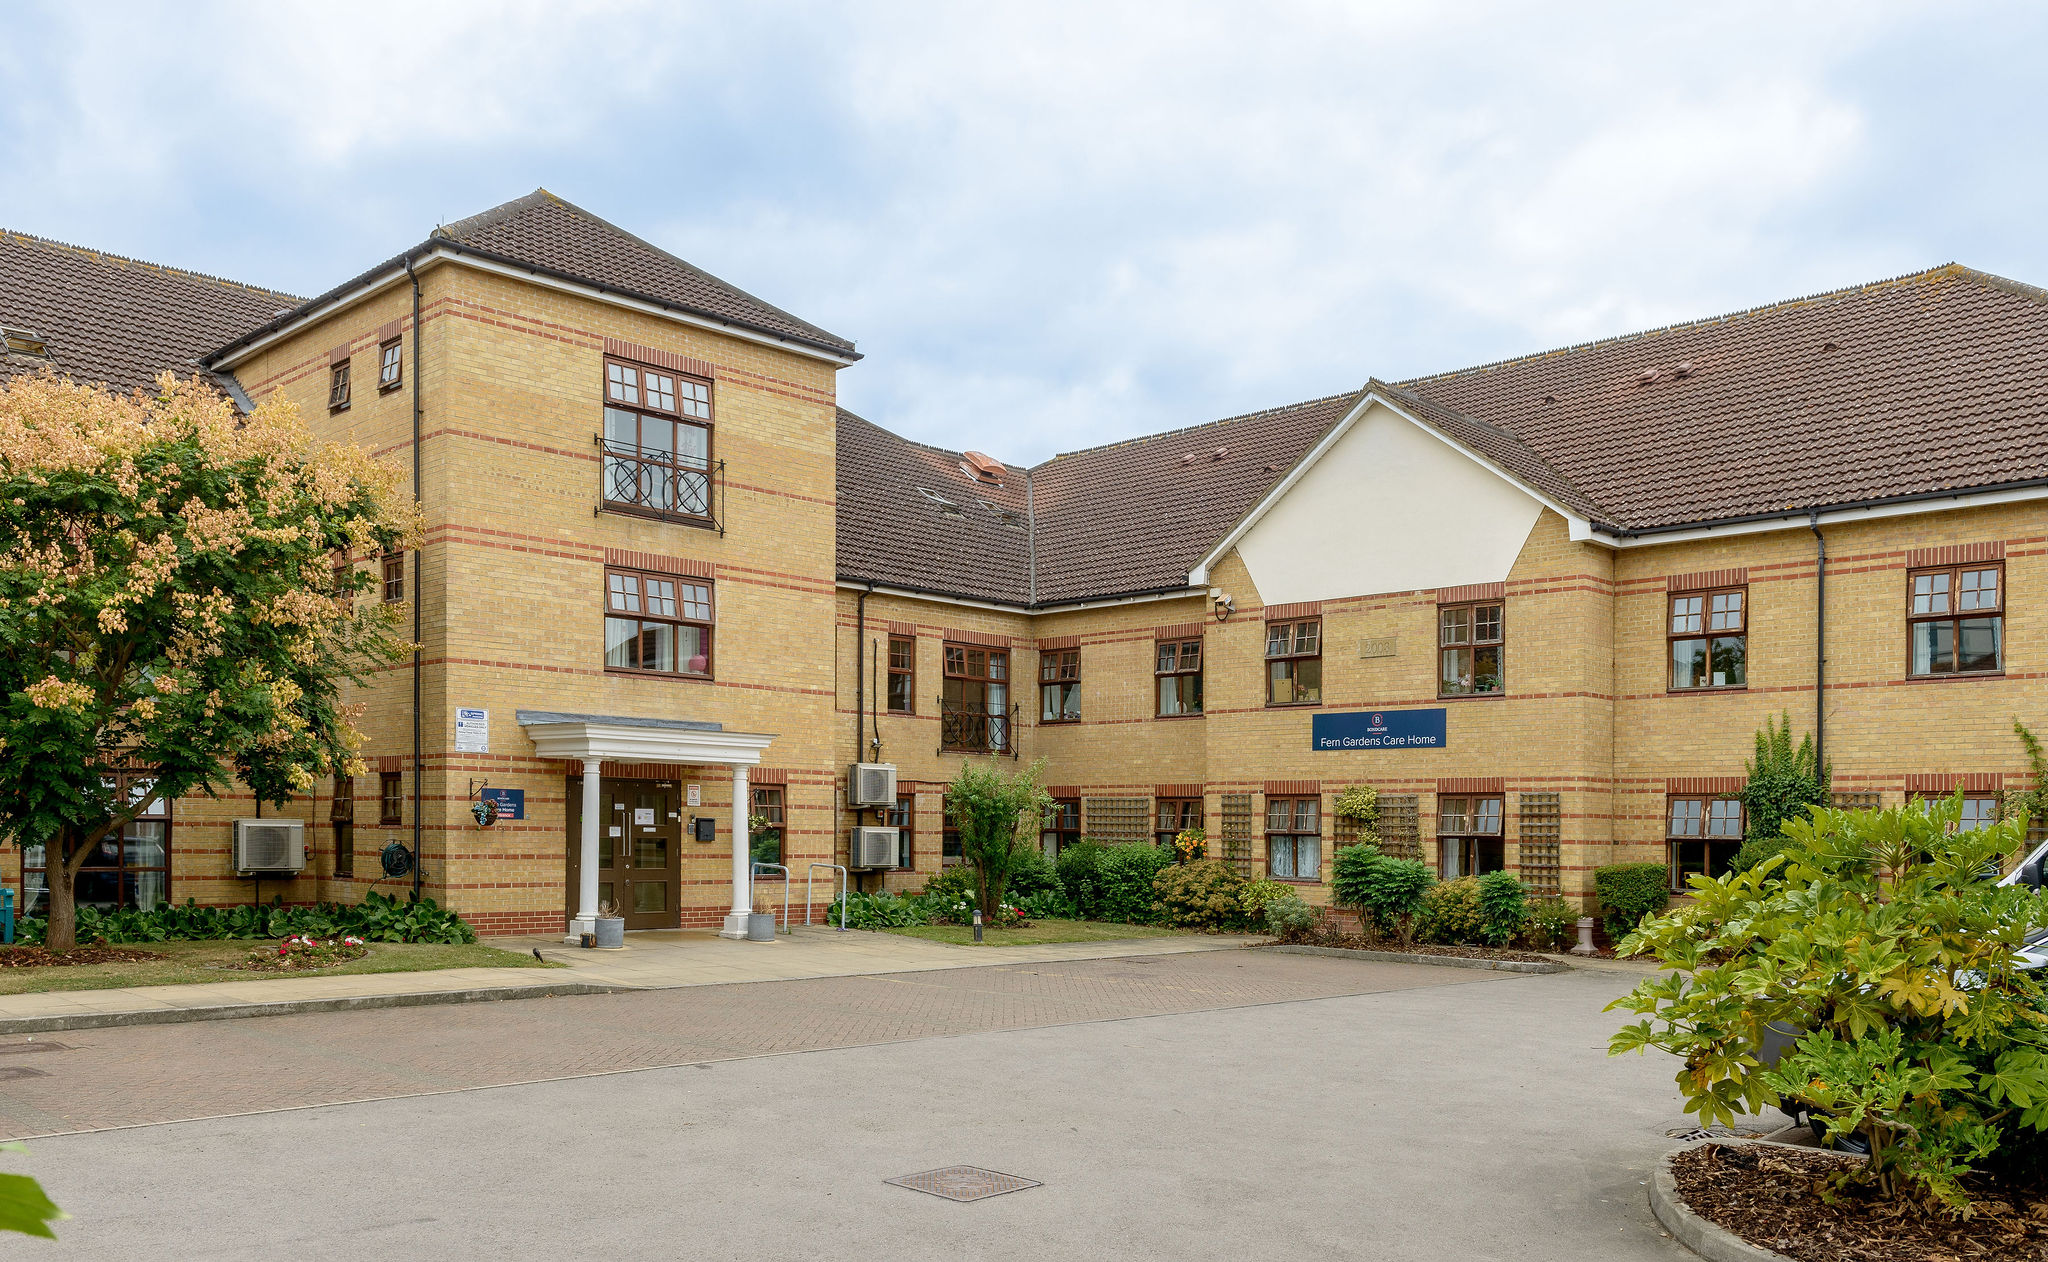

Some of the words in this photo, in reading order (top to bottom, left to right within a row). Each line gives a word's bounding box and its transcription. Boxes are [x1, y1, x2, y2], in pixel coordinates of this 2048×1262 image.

[1374, 716, 1381, 724] B
[1320, 737, 1341, 748] Fern
[1342, 736, 1381, 747] Gardens
[1382, 735, 1405, 746] Care
[1407, 734, 1437, 745] Home
